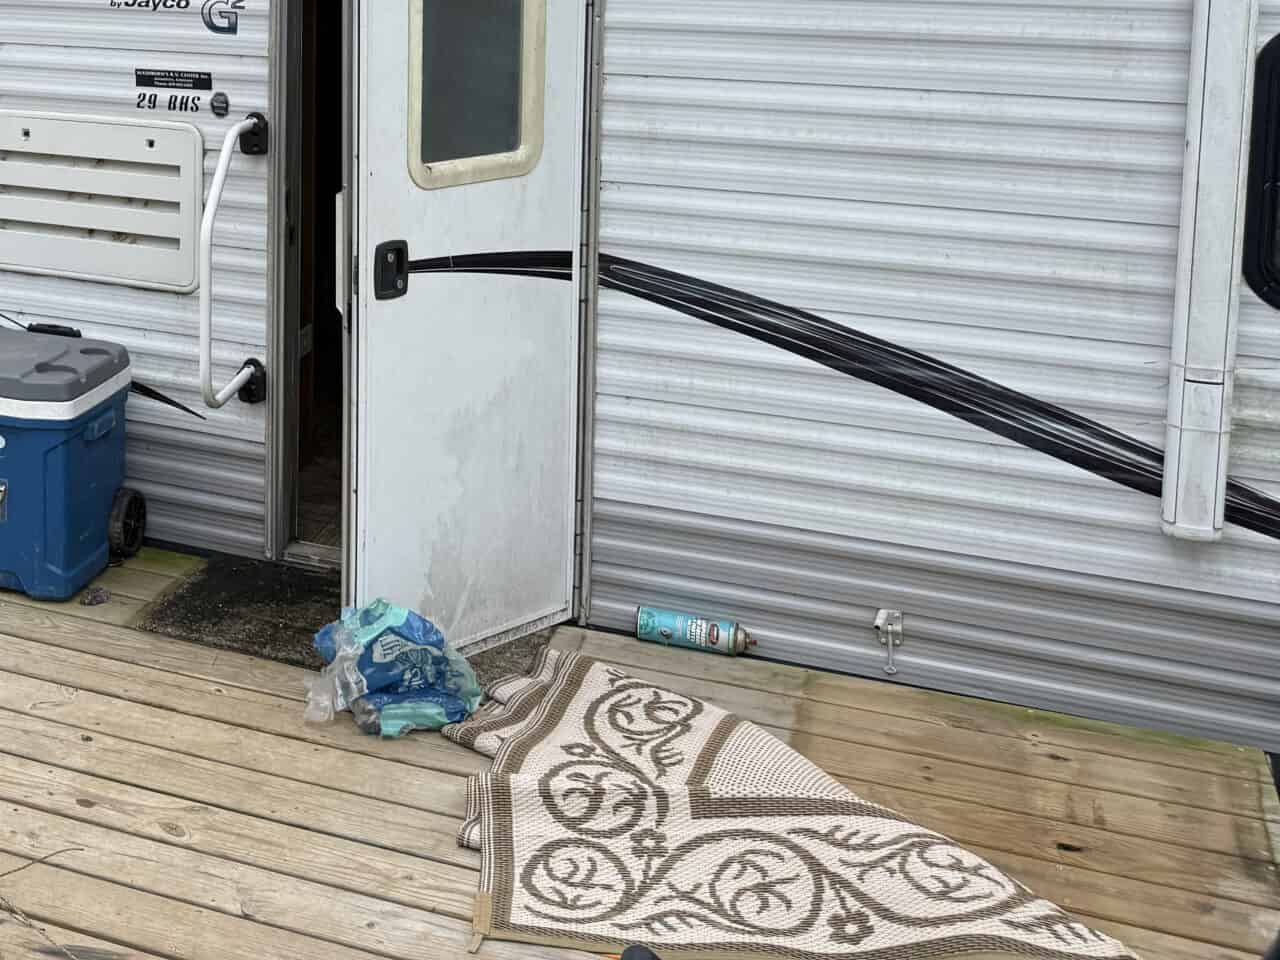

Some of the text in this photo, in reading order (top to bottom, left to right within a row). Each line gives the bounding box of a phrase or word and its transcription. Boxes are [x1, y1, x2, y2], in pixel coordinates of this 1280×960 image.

[110, 0, 122, 8] by
[136, 92, 158, 110] 29
[167, 94, 201, 112] BHS
